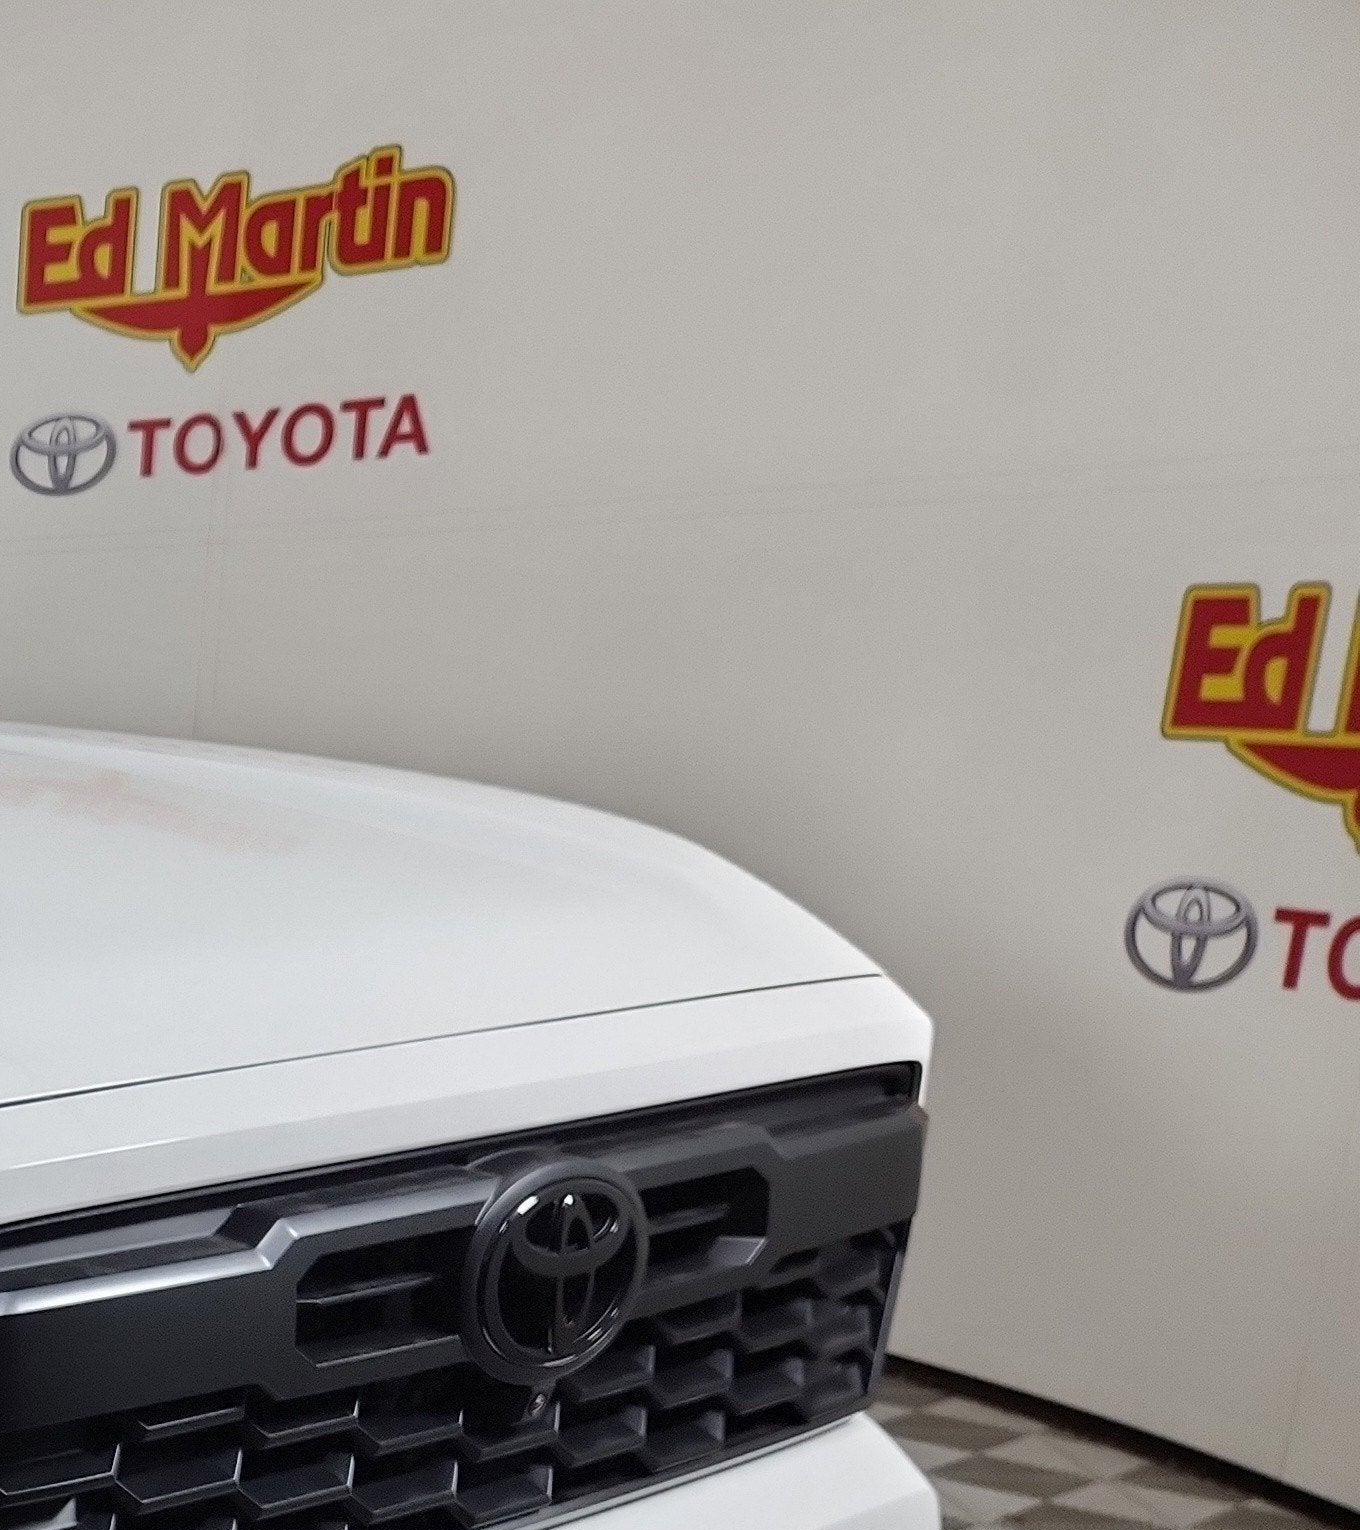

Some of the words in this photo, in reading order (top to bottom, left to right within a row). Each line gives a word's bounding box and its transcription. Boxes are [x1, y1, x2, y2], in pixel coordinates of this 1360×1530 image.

[18, 188, 138, 312] Ed
[158, 146, 456, 292] Martin
[128, 394, 430, 478] TOYOTA
[1162, 582, 1330, 739] Ed
